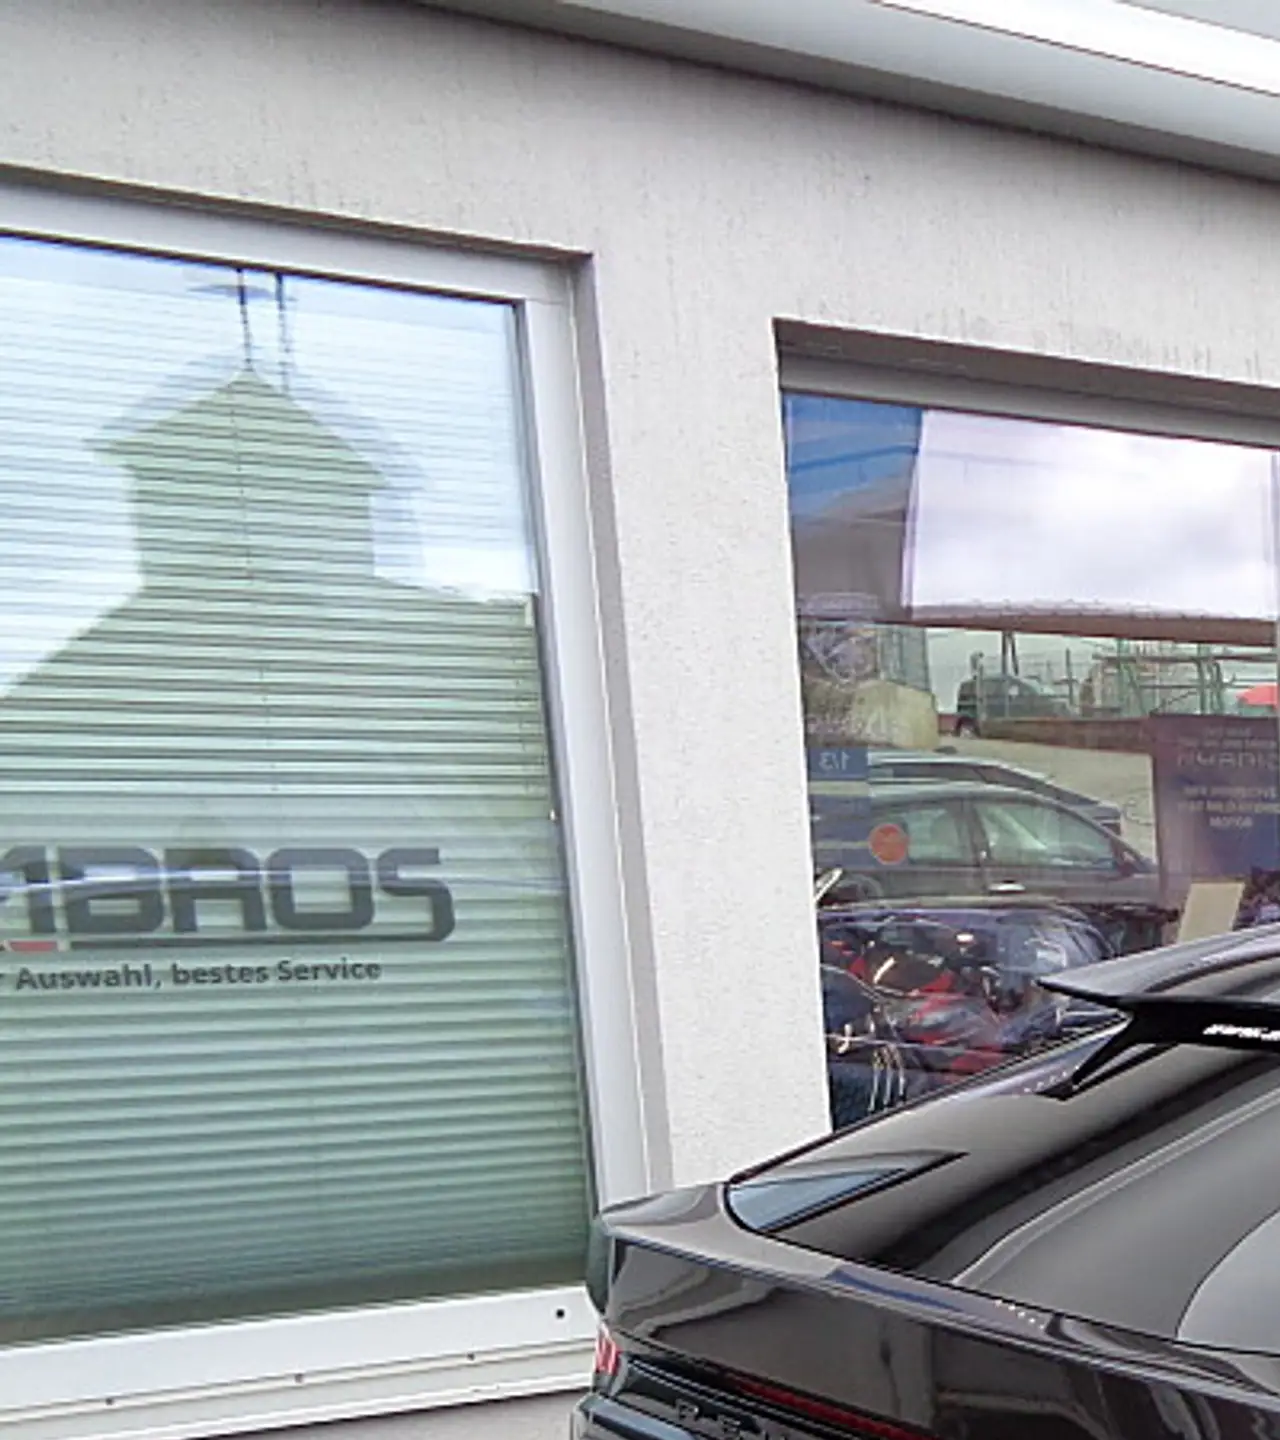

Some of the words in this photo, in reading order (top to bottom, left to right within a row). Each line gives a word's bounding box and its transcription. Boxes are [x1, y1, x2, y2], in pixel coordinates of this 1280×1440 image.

[15, 963, 162, 990] Auswahl,
[171, 962, 269, 985] bestes
[277, 958, 382, 981] Service
